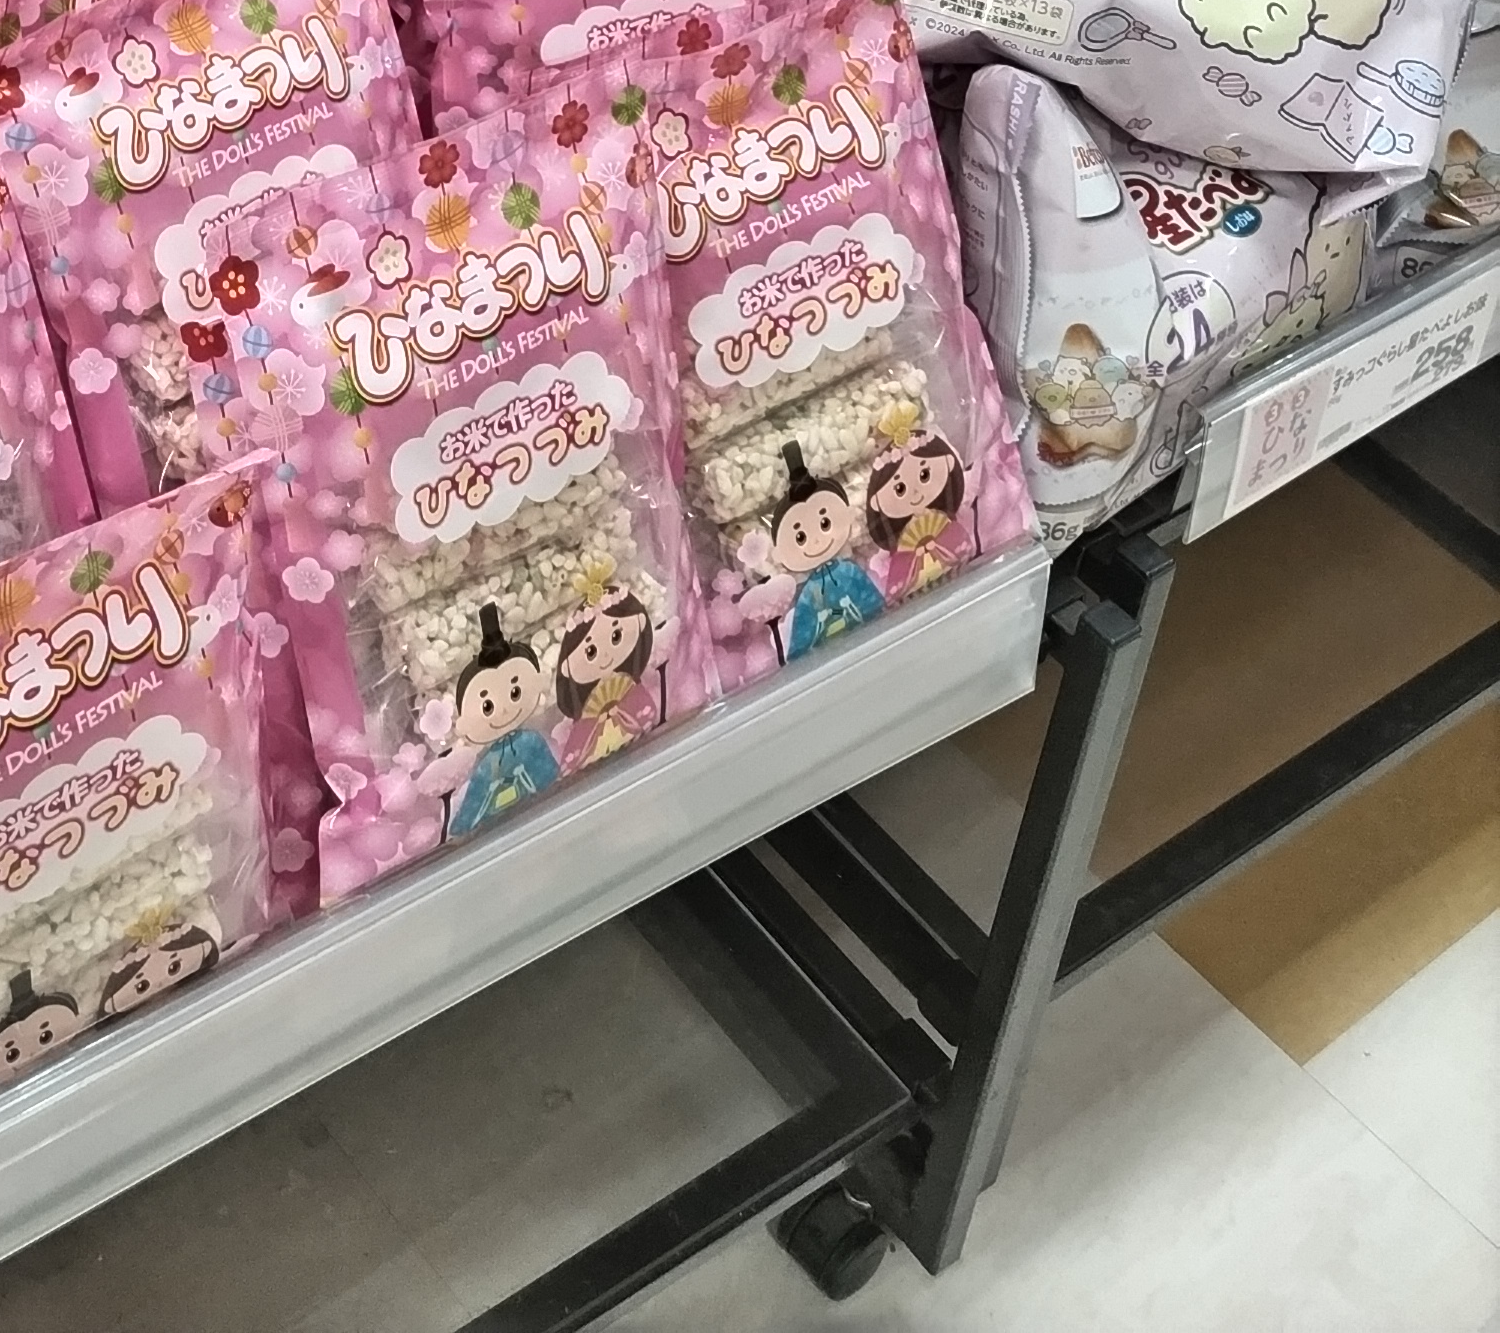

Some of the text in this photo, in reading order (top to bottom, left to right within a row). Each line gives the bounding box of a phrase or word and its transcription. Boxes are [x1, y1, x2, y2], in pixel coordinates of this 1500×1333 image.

[100, 14, 351, 191] ひなまつり
[173, 158, 213, 190] THE
[265, 102, 333, 152] FESTIVAL
[660, 84, 889, 264] ひなまつり
[708, 223, 749, 258] THE
[802, 171, 871, 218] FESTIVAL
[332, 209, 612, 403] ひなまつり
[717, 265, 901, 375] ひなつづみ
[739, 240, 868, 318] お米で作った
[417, 370, 458, 402] THE
[518, 306, 590, 357] FESTIVAL
[413, 406, 610, 529] ひなつづみ
[440, 381, 578, 462] お米で作った
[74, 671, 163, 733] FESTIVAL
